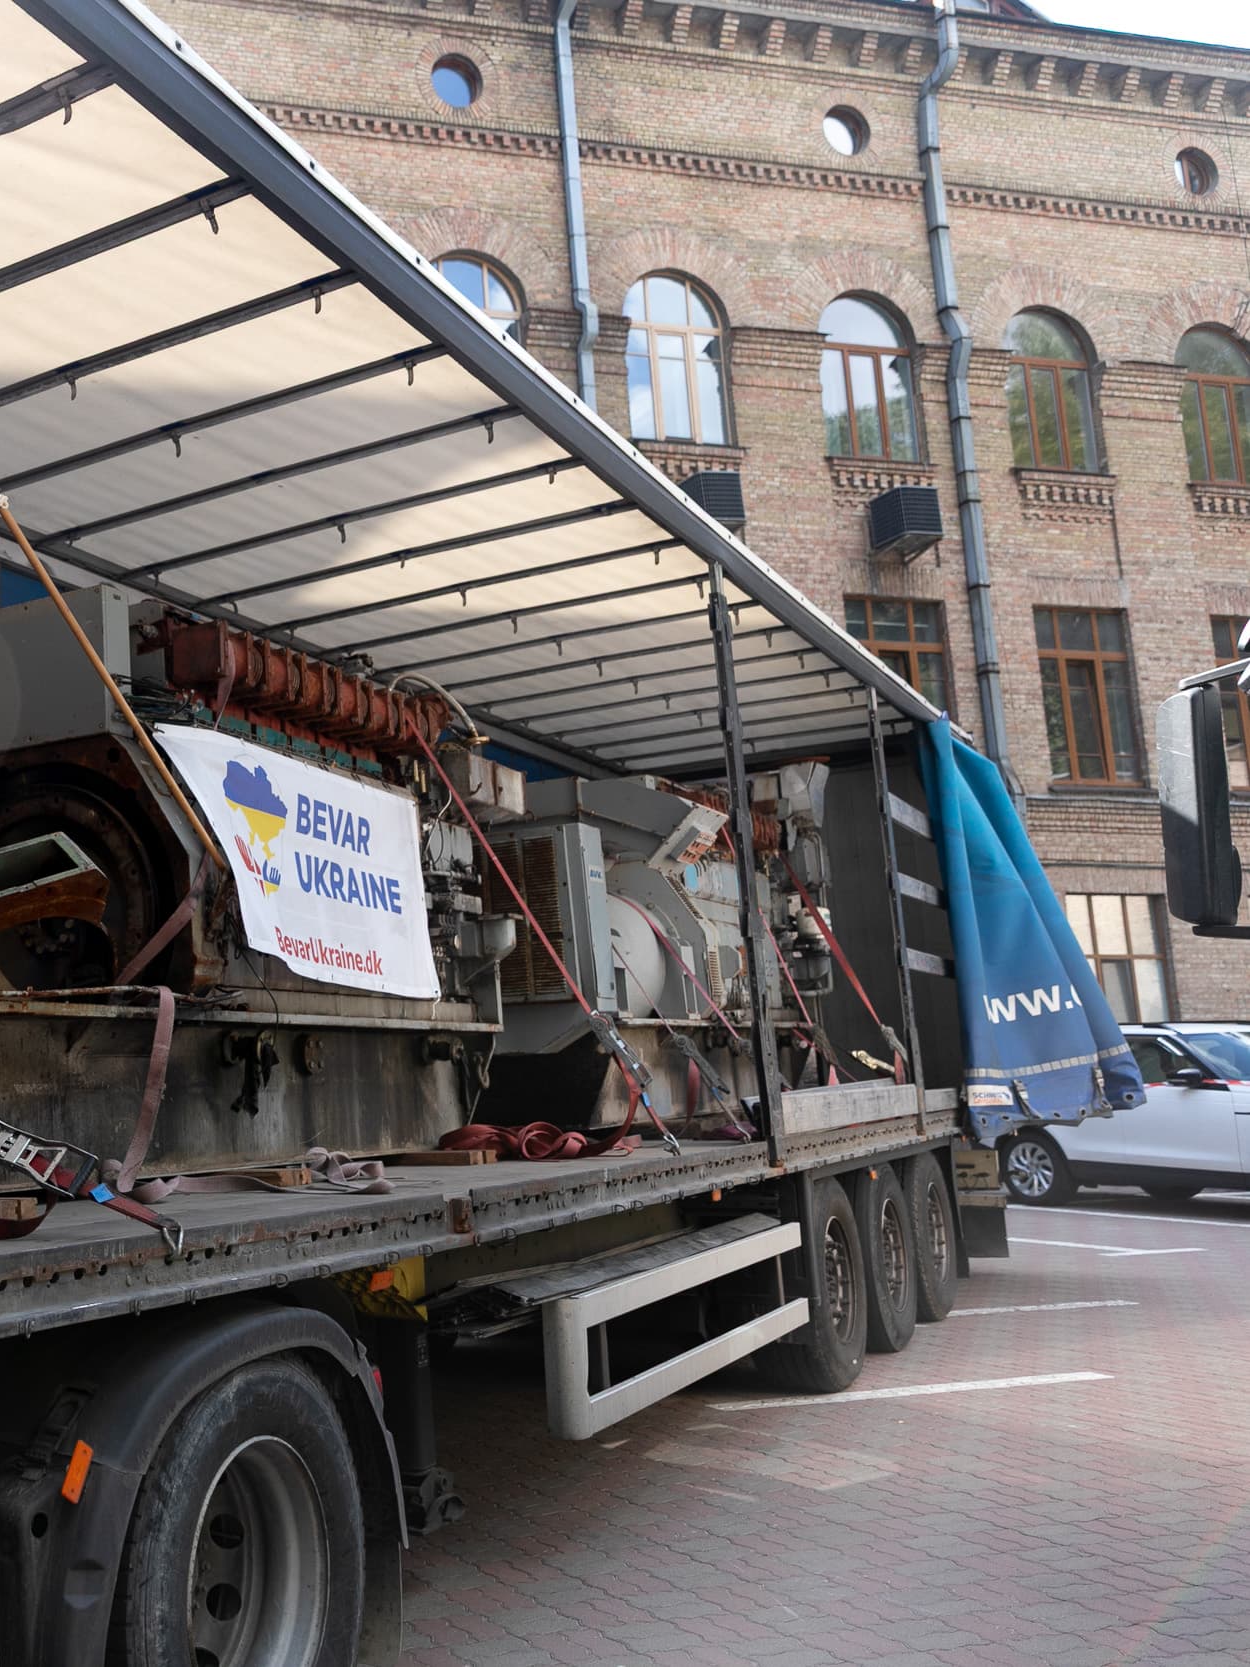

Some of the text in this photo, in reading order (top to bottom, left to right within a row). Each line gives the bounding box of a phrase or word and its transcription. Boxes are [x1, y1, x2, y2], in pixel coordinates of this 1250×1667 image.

[296, 793, 370, 856] BEVAR
[294, 851, 402, 915] UKRAINE
[275, 926, 383, 976] BevarUkraine.dk
